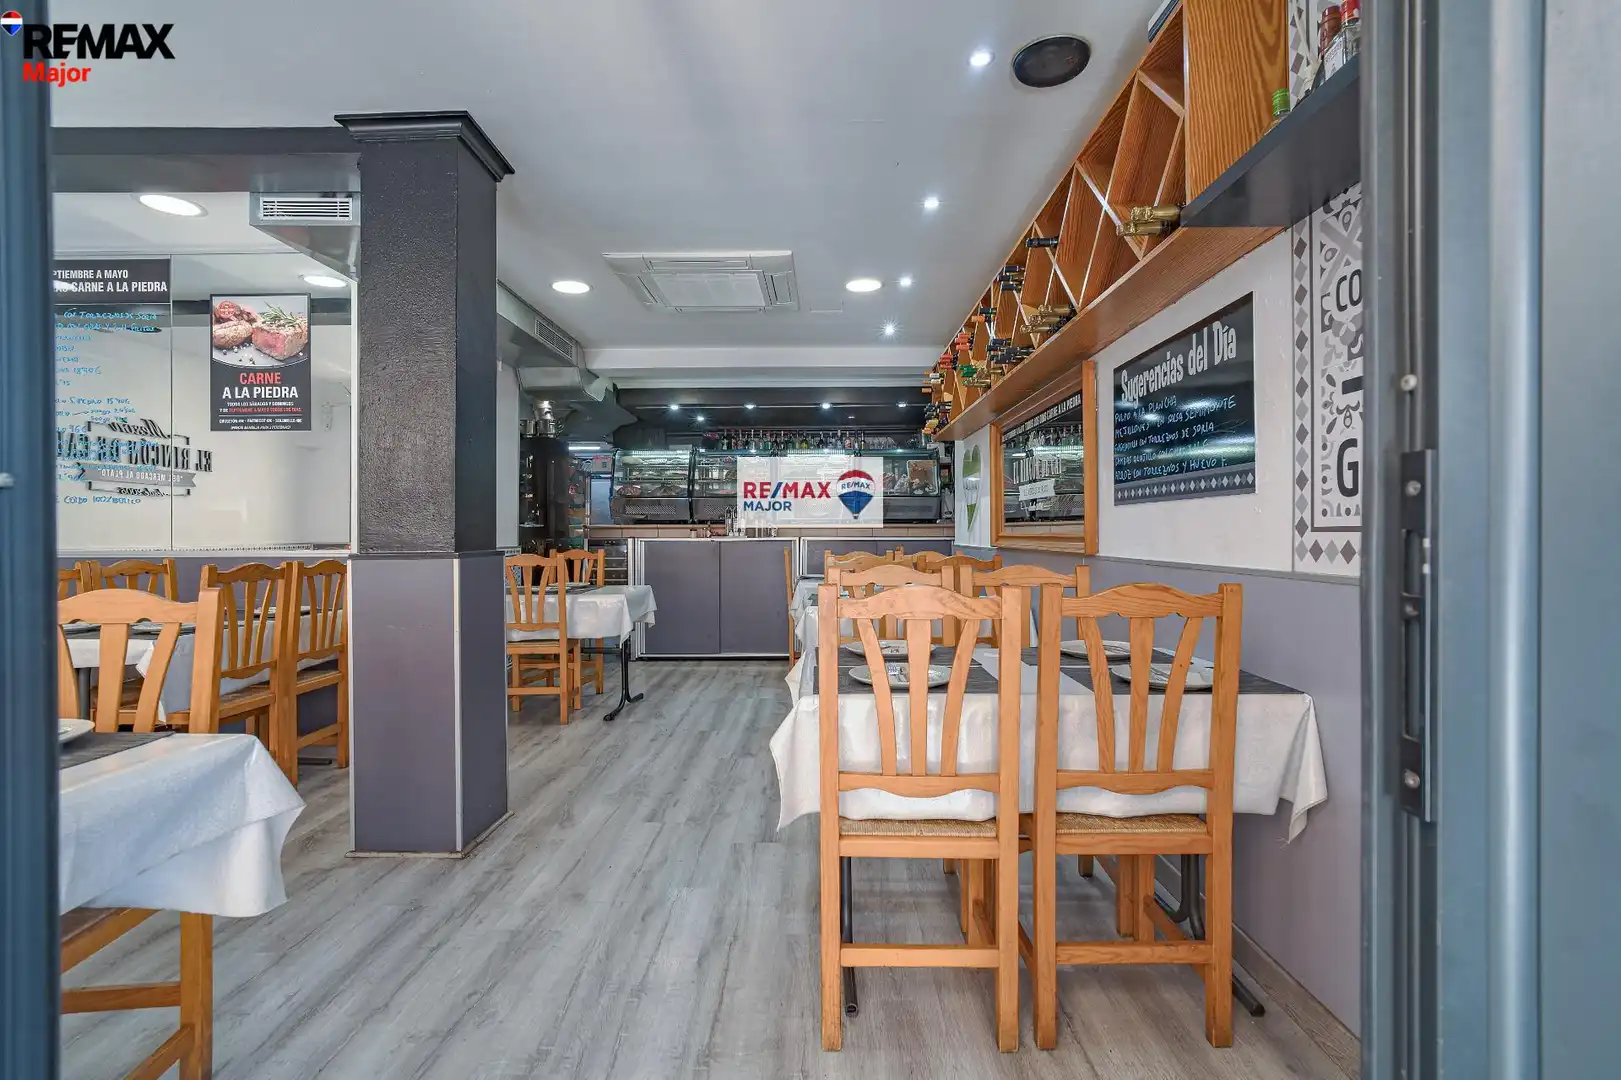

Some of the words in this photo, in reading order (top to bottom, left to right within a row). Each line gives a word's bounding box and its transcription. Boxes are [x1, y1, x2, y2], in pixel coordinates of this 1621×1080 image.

[96, 270, 102, 279] A
[104, 269, 129, 279] MAYO
[106, 281, 114, 292] A
[116, 281, 129, 292] LA
[131, 281, 168, 292] PIEDRA
[1121, 351, 1184, 409] Sugerencias
[1188, 327, 1208, 376] del
[1213, 320, 1236, 366] Día
[239, 372, 282, 385] CARNE
[222, 387, 232, 399] A
[235, 387, 250, 399] LA
[253, 386, 299, 399] PIEDRA
